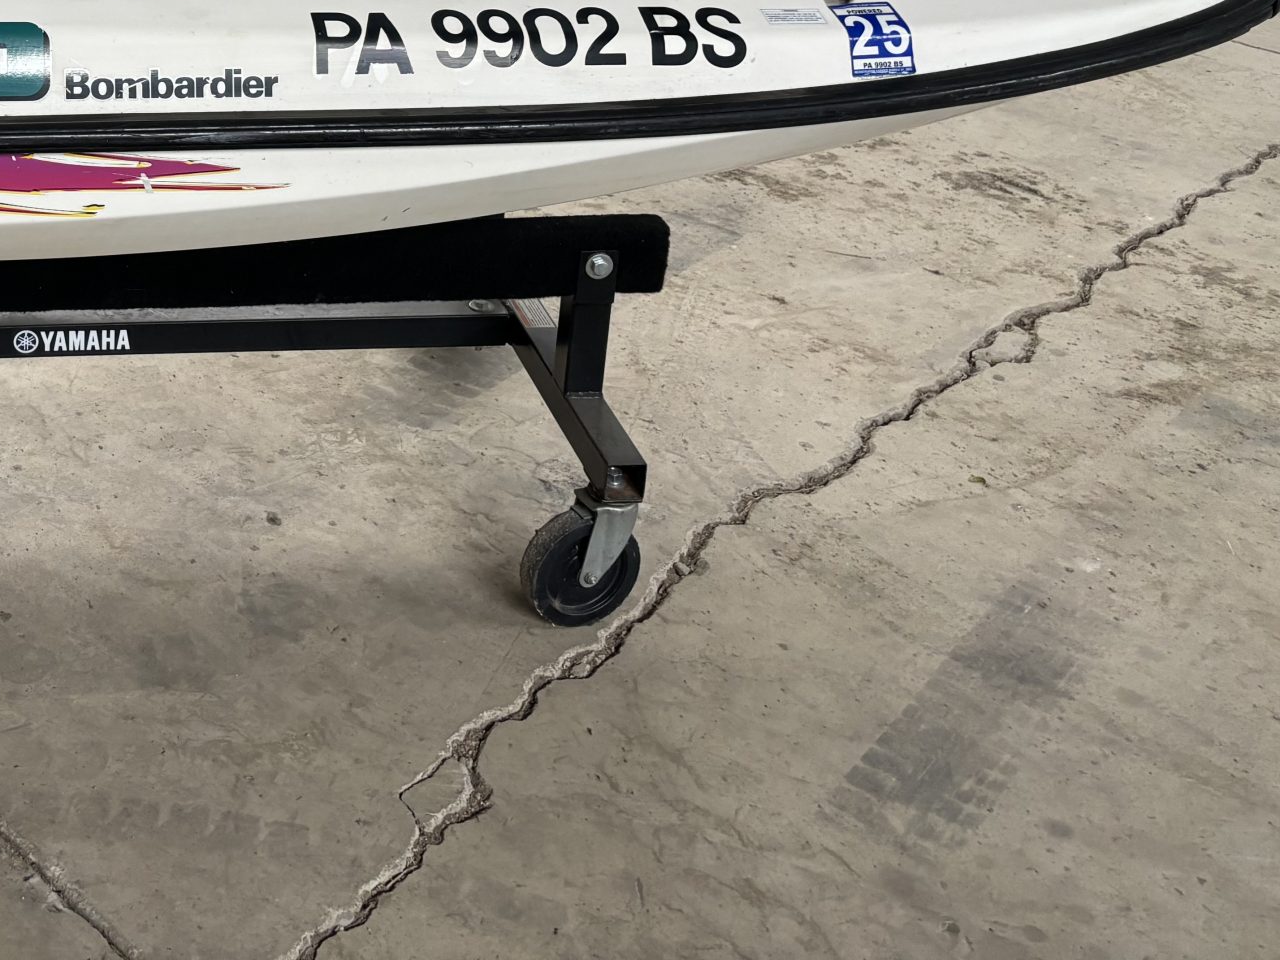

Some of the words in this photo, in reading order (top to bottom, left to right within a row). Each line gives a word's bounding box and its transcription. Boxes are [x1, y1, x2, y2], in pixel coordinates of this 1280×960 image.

[310, 12, 415, 75] PA
[431, 7, 627, 69] 9902
[638, 6, 747, 69] BS
[843, 15, 911, 57] 25
[65, 68, 279, 100] Bombardier
[40, 329, 131, 352] YAMAHA
